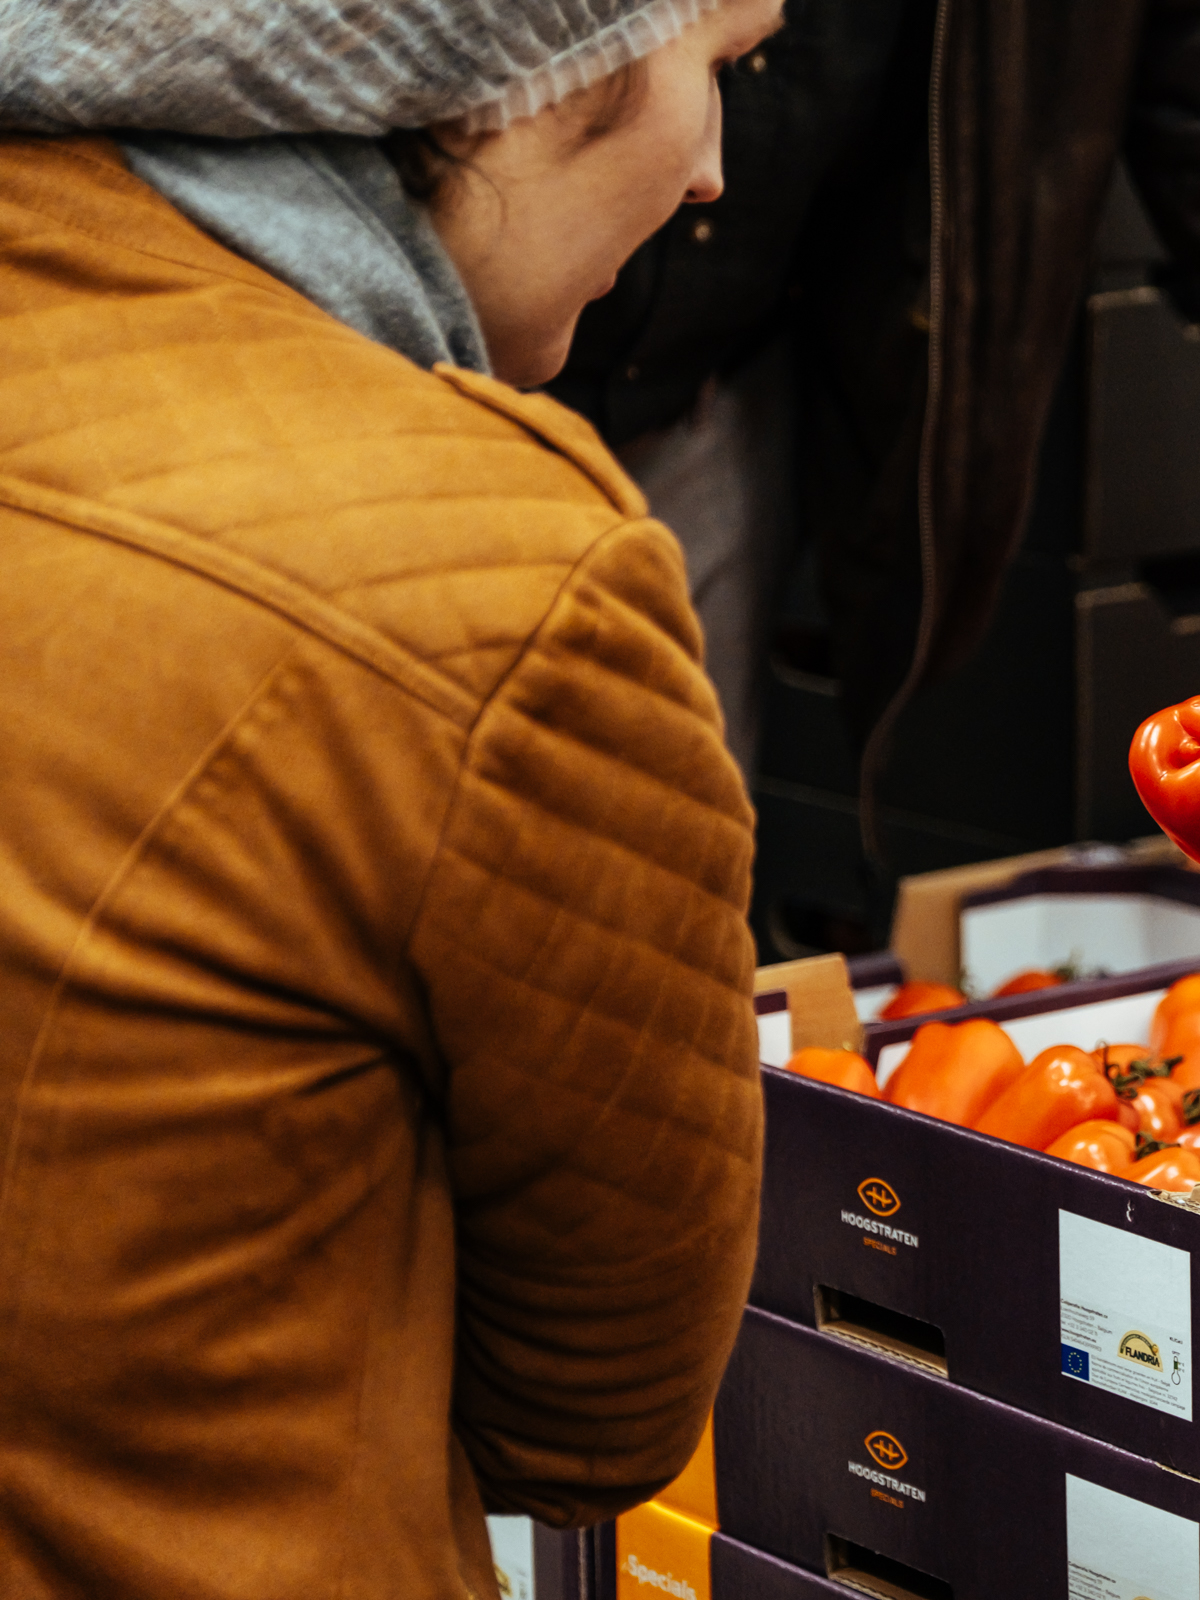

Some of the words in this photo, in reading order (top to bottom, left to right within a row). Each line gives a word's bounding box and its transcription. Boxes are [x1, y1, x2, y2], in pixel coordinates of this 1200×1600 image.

[841, 1208, 919, 1249] HOOGSTRATEN
[863, 1236, 897, 1256] SPECIALS
[1125, 1346, 1160, 1368] FLANDRIA
[847, 1459, 926, 1502] HOOGSTRATEN
